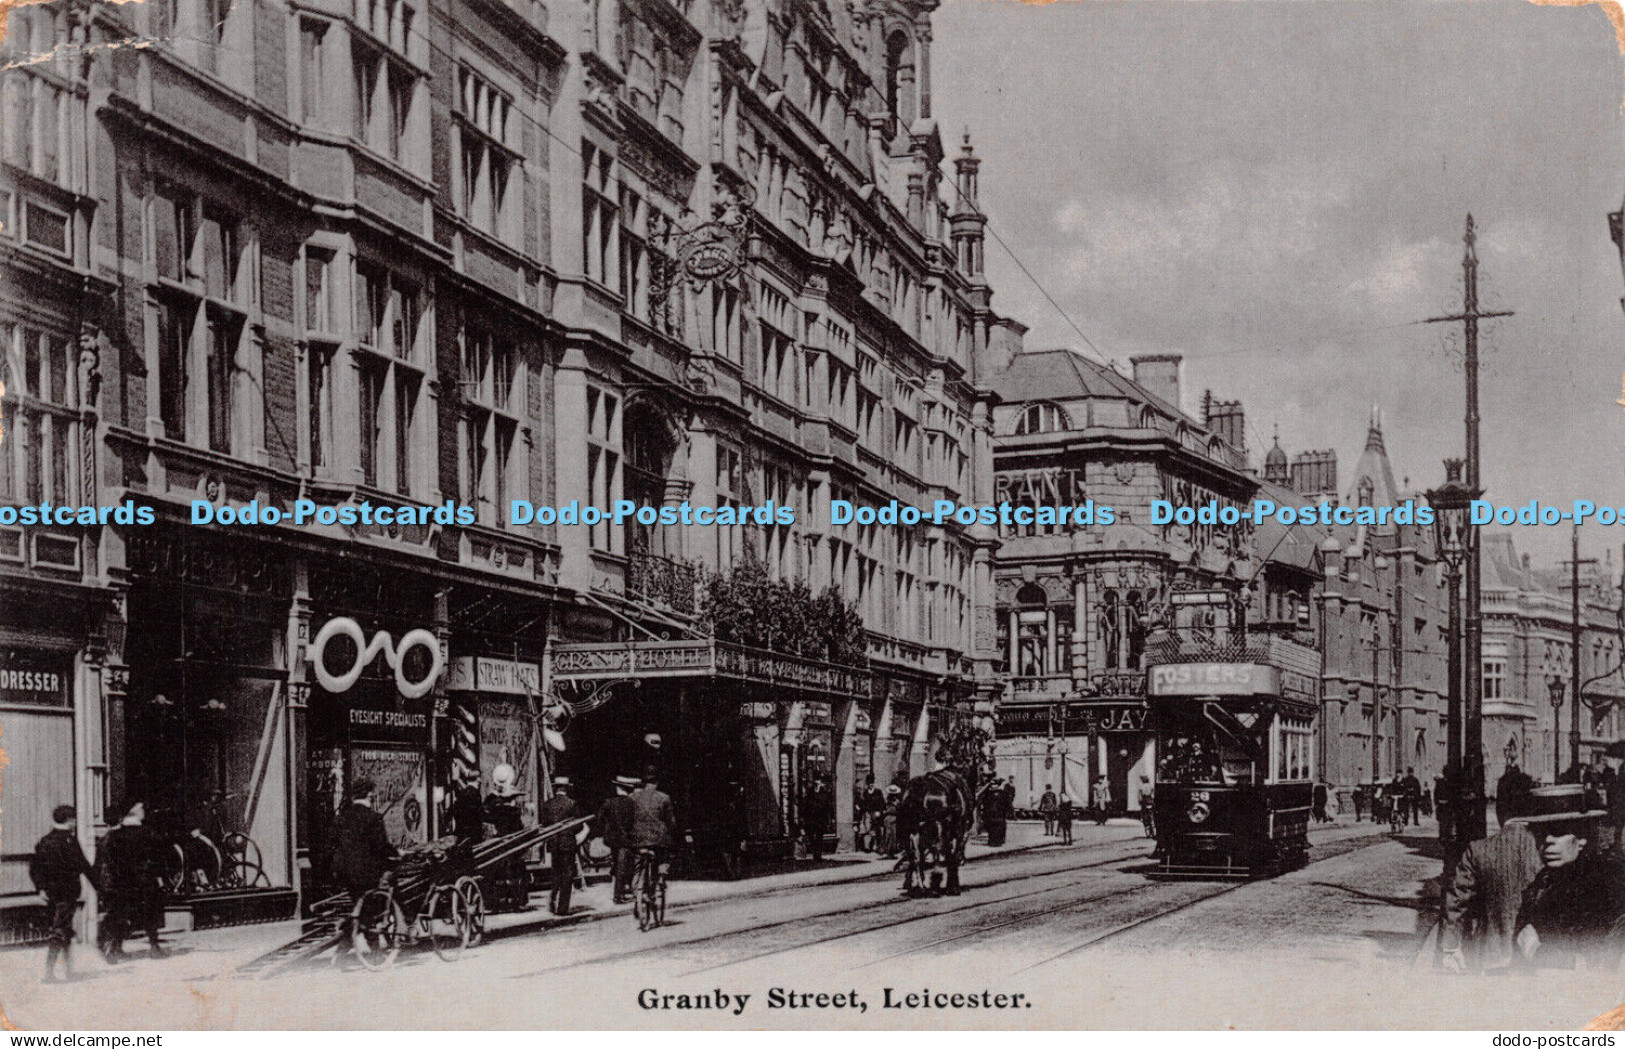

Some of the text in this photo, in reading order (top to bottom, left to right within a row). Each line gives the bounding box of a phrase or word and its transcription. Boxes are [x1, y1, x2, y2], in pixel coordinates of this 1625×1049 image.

[1, 669, 59, 692] DRESSER
[350, 708, 426, 728] EYESIGHT SPECIALISTS
[1101, 709, 1148, 729] JAY
